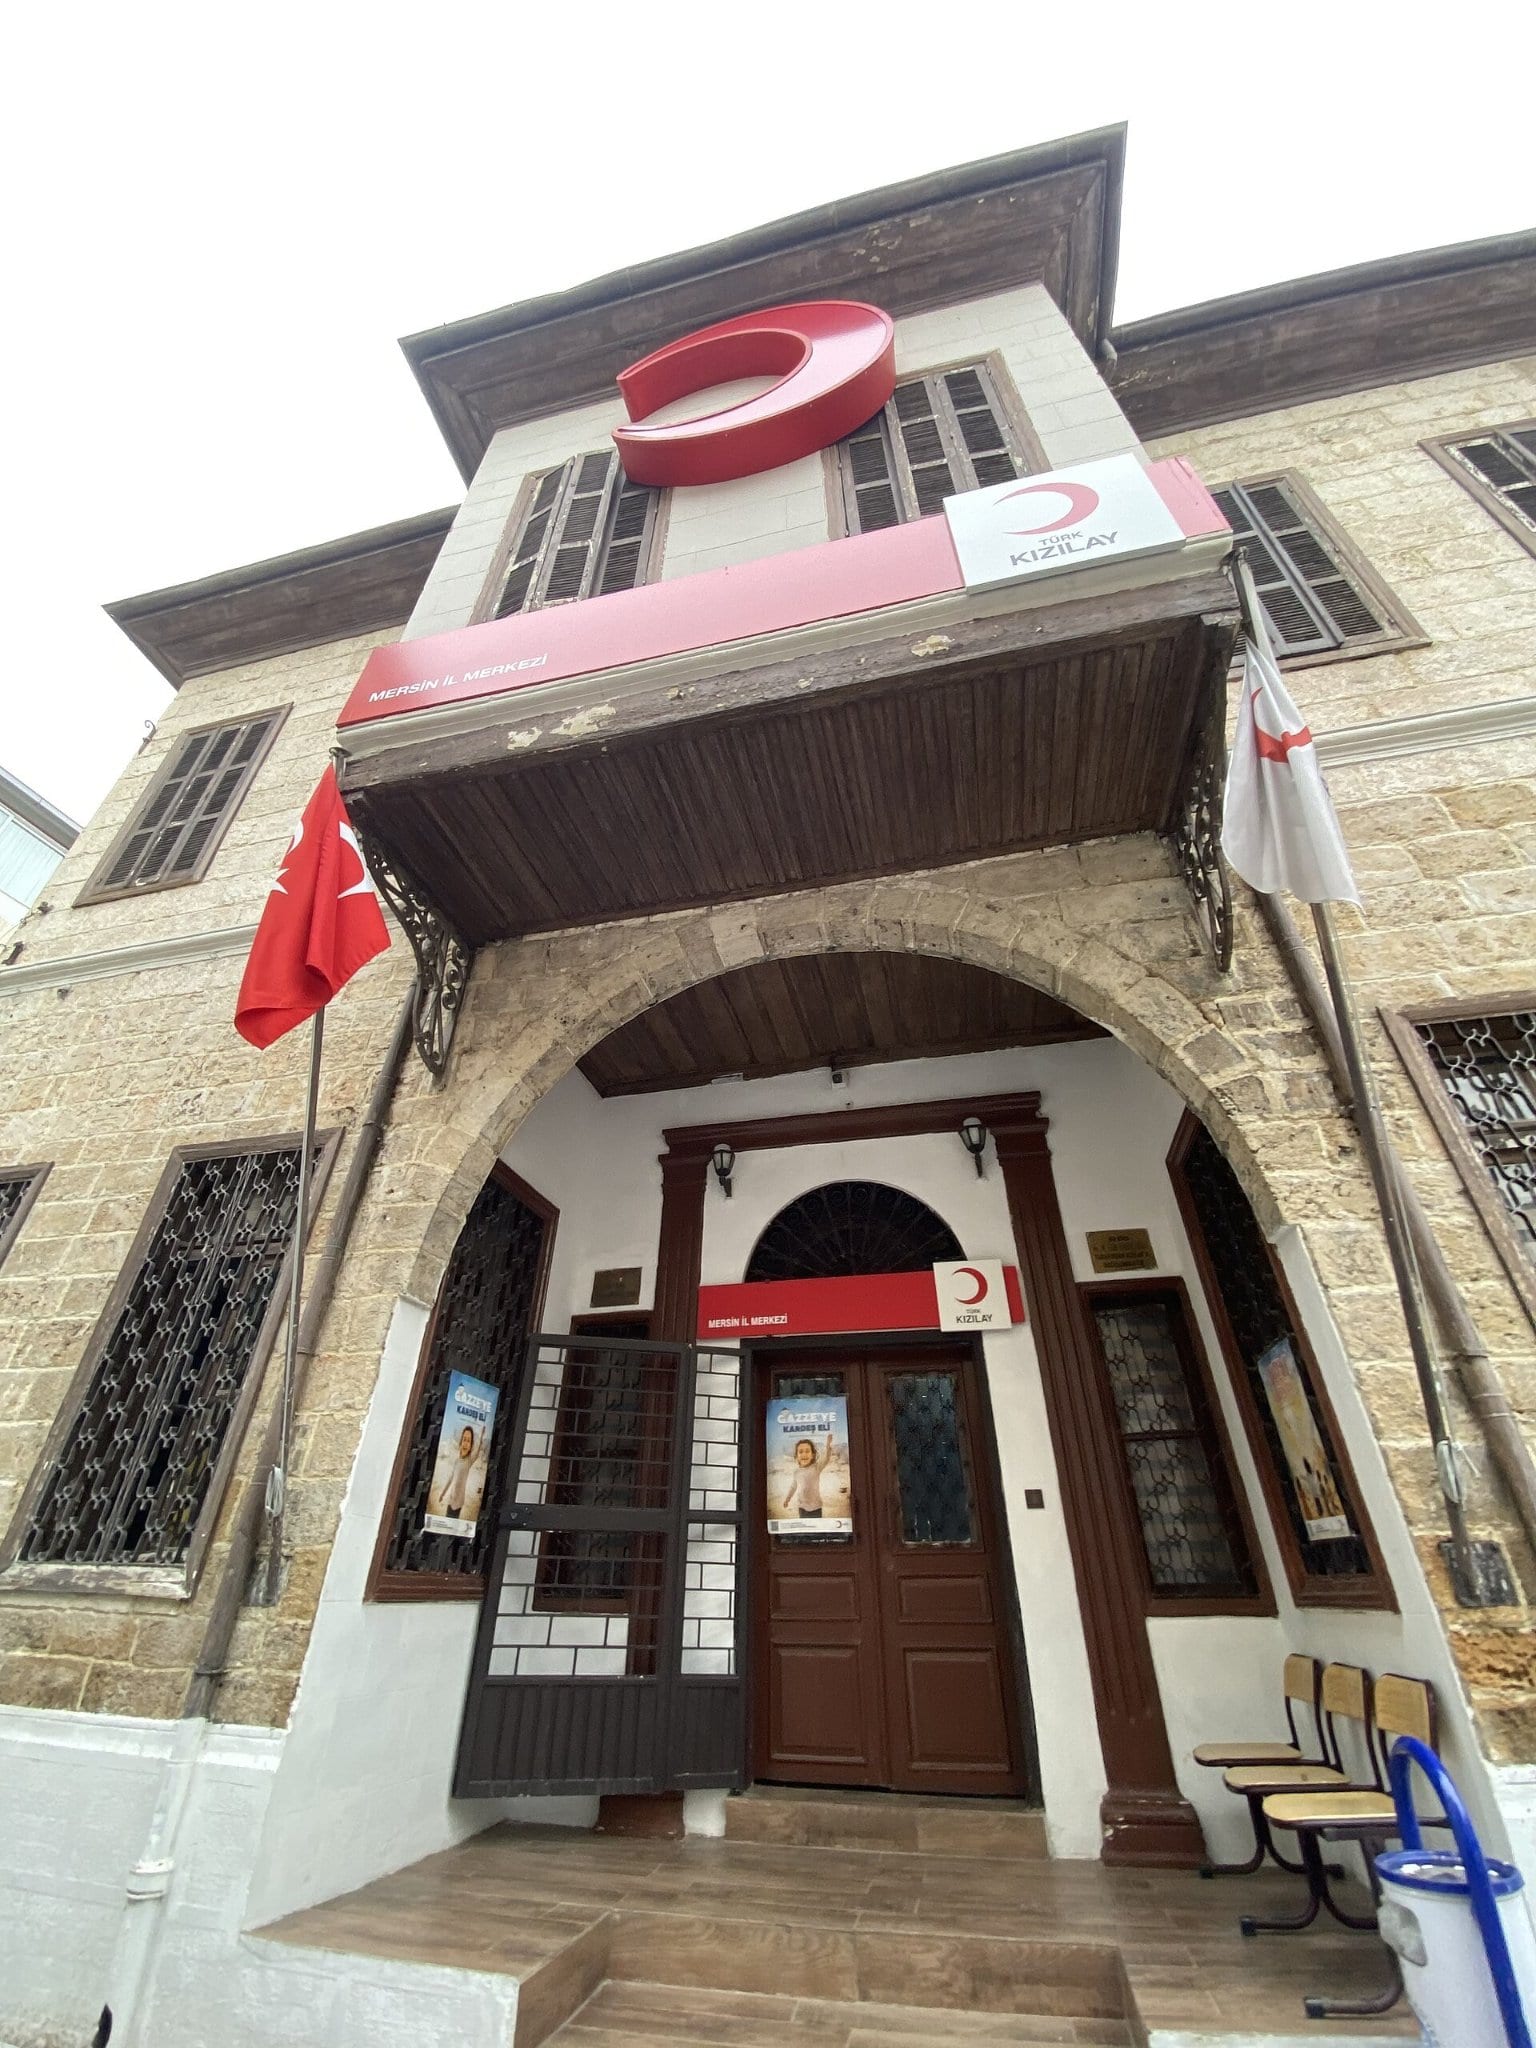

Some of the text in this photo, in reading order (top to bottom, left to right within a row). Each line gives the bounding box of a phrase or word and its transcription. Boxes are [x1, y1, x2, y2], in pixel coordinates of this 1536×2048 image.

[1039, 531, 1084, 545] TÜRK
[1010, 531, 1119, 566] KIZILAY
[368, 654, 547, 703] MERSİN İL MERKEZİ
[708, 1313, 788, 1328] MERSİN İL MERKEZİ
[956, 1314, 993, 1324] KIZILAY
[783, 1422, 831, 1434] KARDEŞ ELİ
